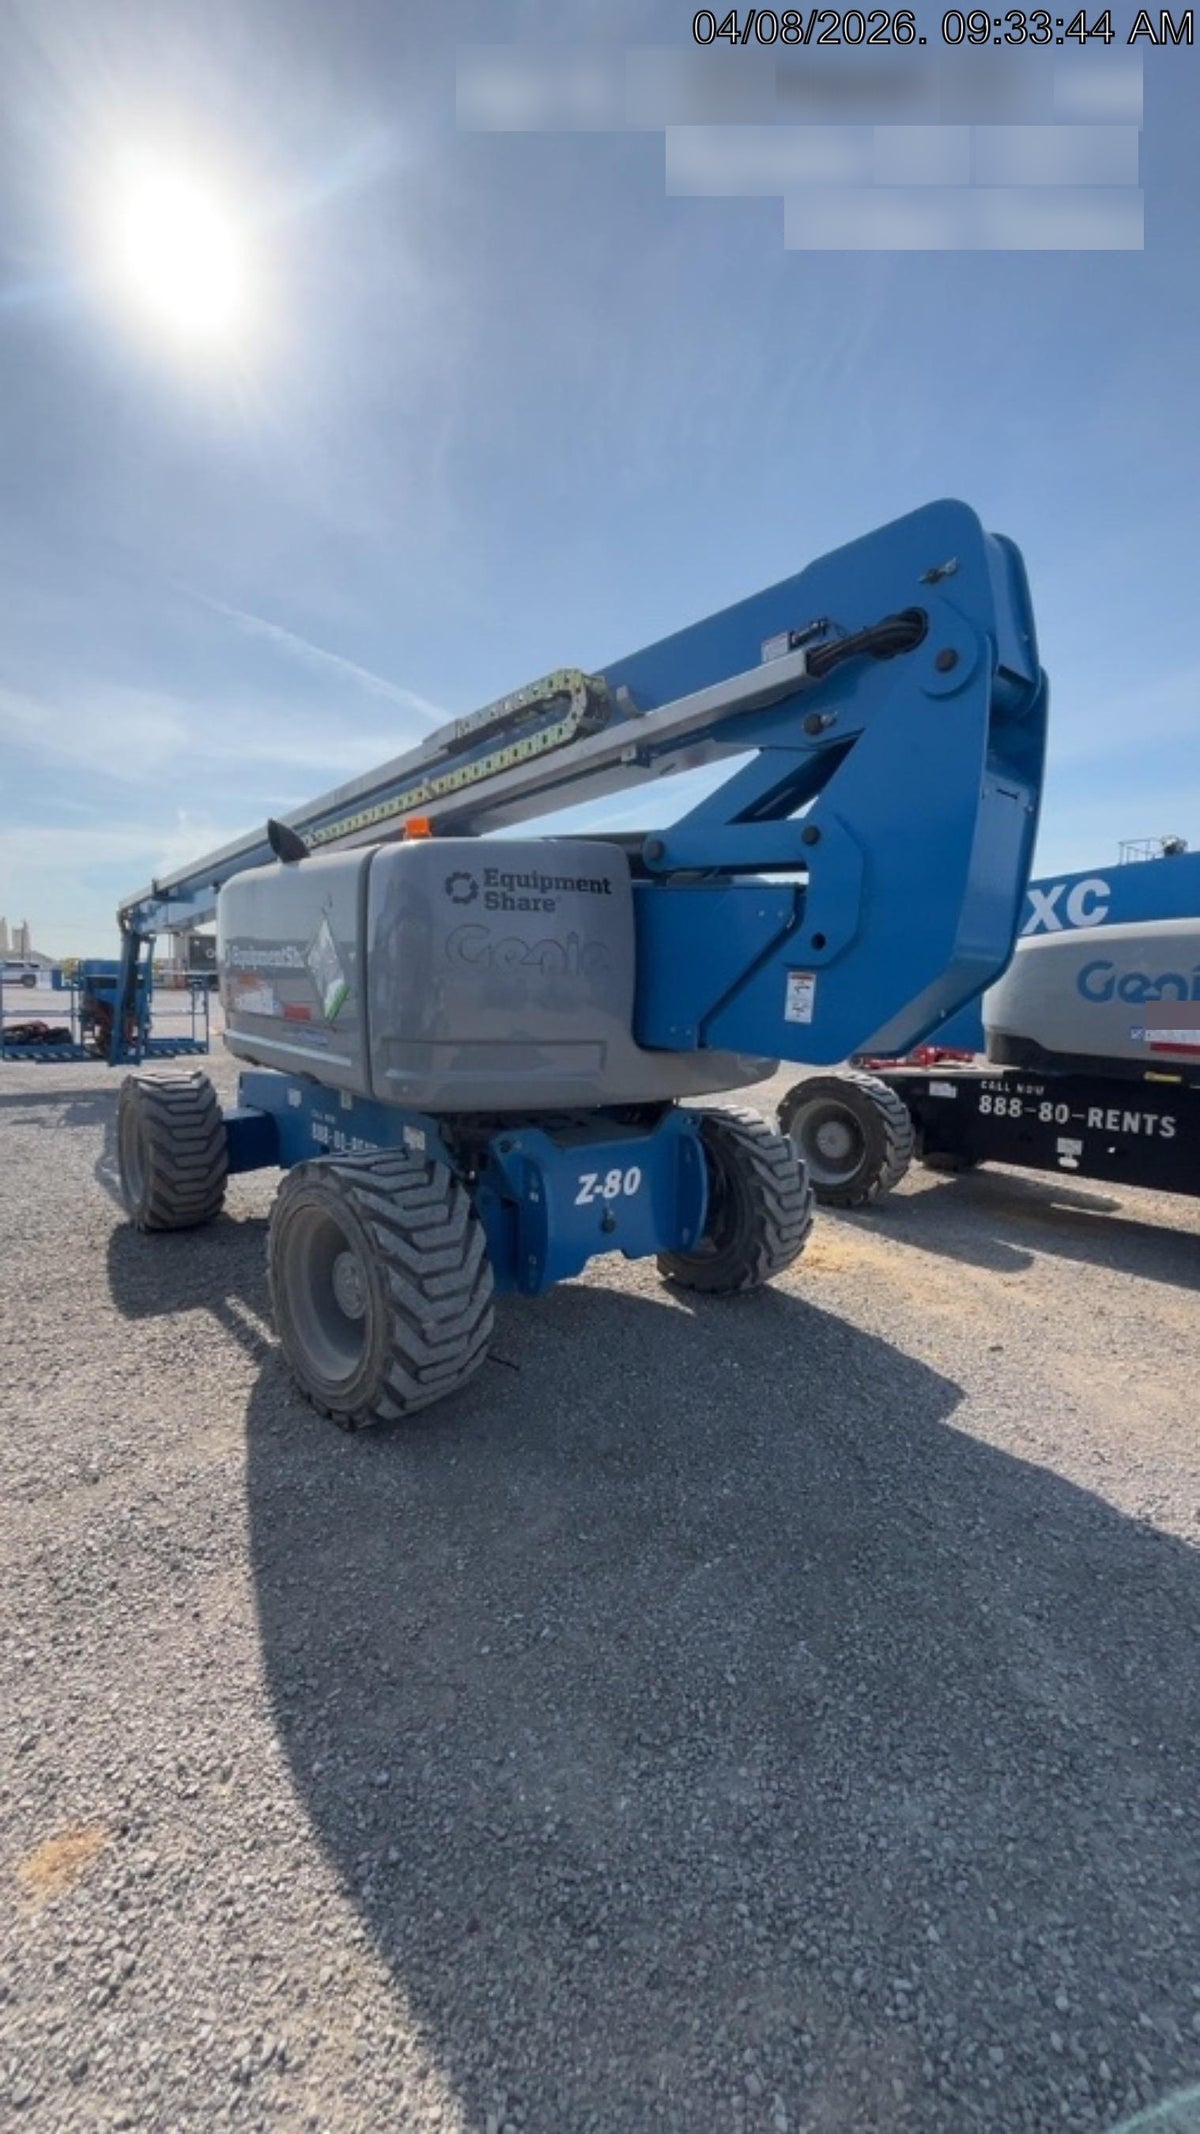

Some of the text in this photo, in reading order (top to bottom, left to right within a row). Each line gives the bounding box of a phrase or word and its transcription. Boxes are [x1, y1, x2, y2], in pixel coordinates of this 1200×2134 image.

[484, 867, 612, 895] Equipment
[484, 891, 556, 912] Share
[1021, 879, 1112, 935] XC
[980, 1080, 1045, 1096] CALL NOW
[979, 1094, 1176, 1138] 888-80-RENTS
[575, 1166, 641, 1205] Z-80
